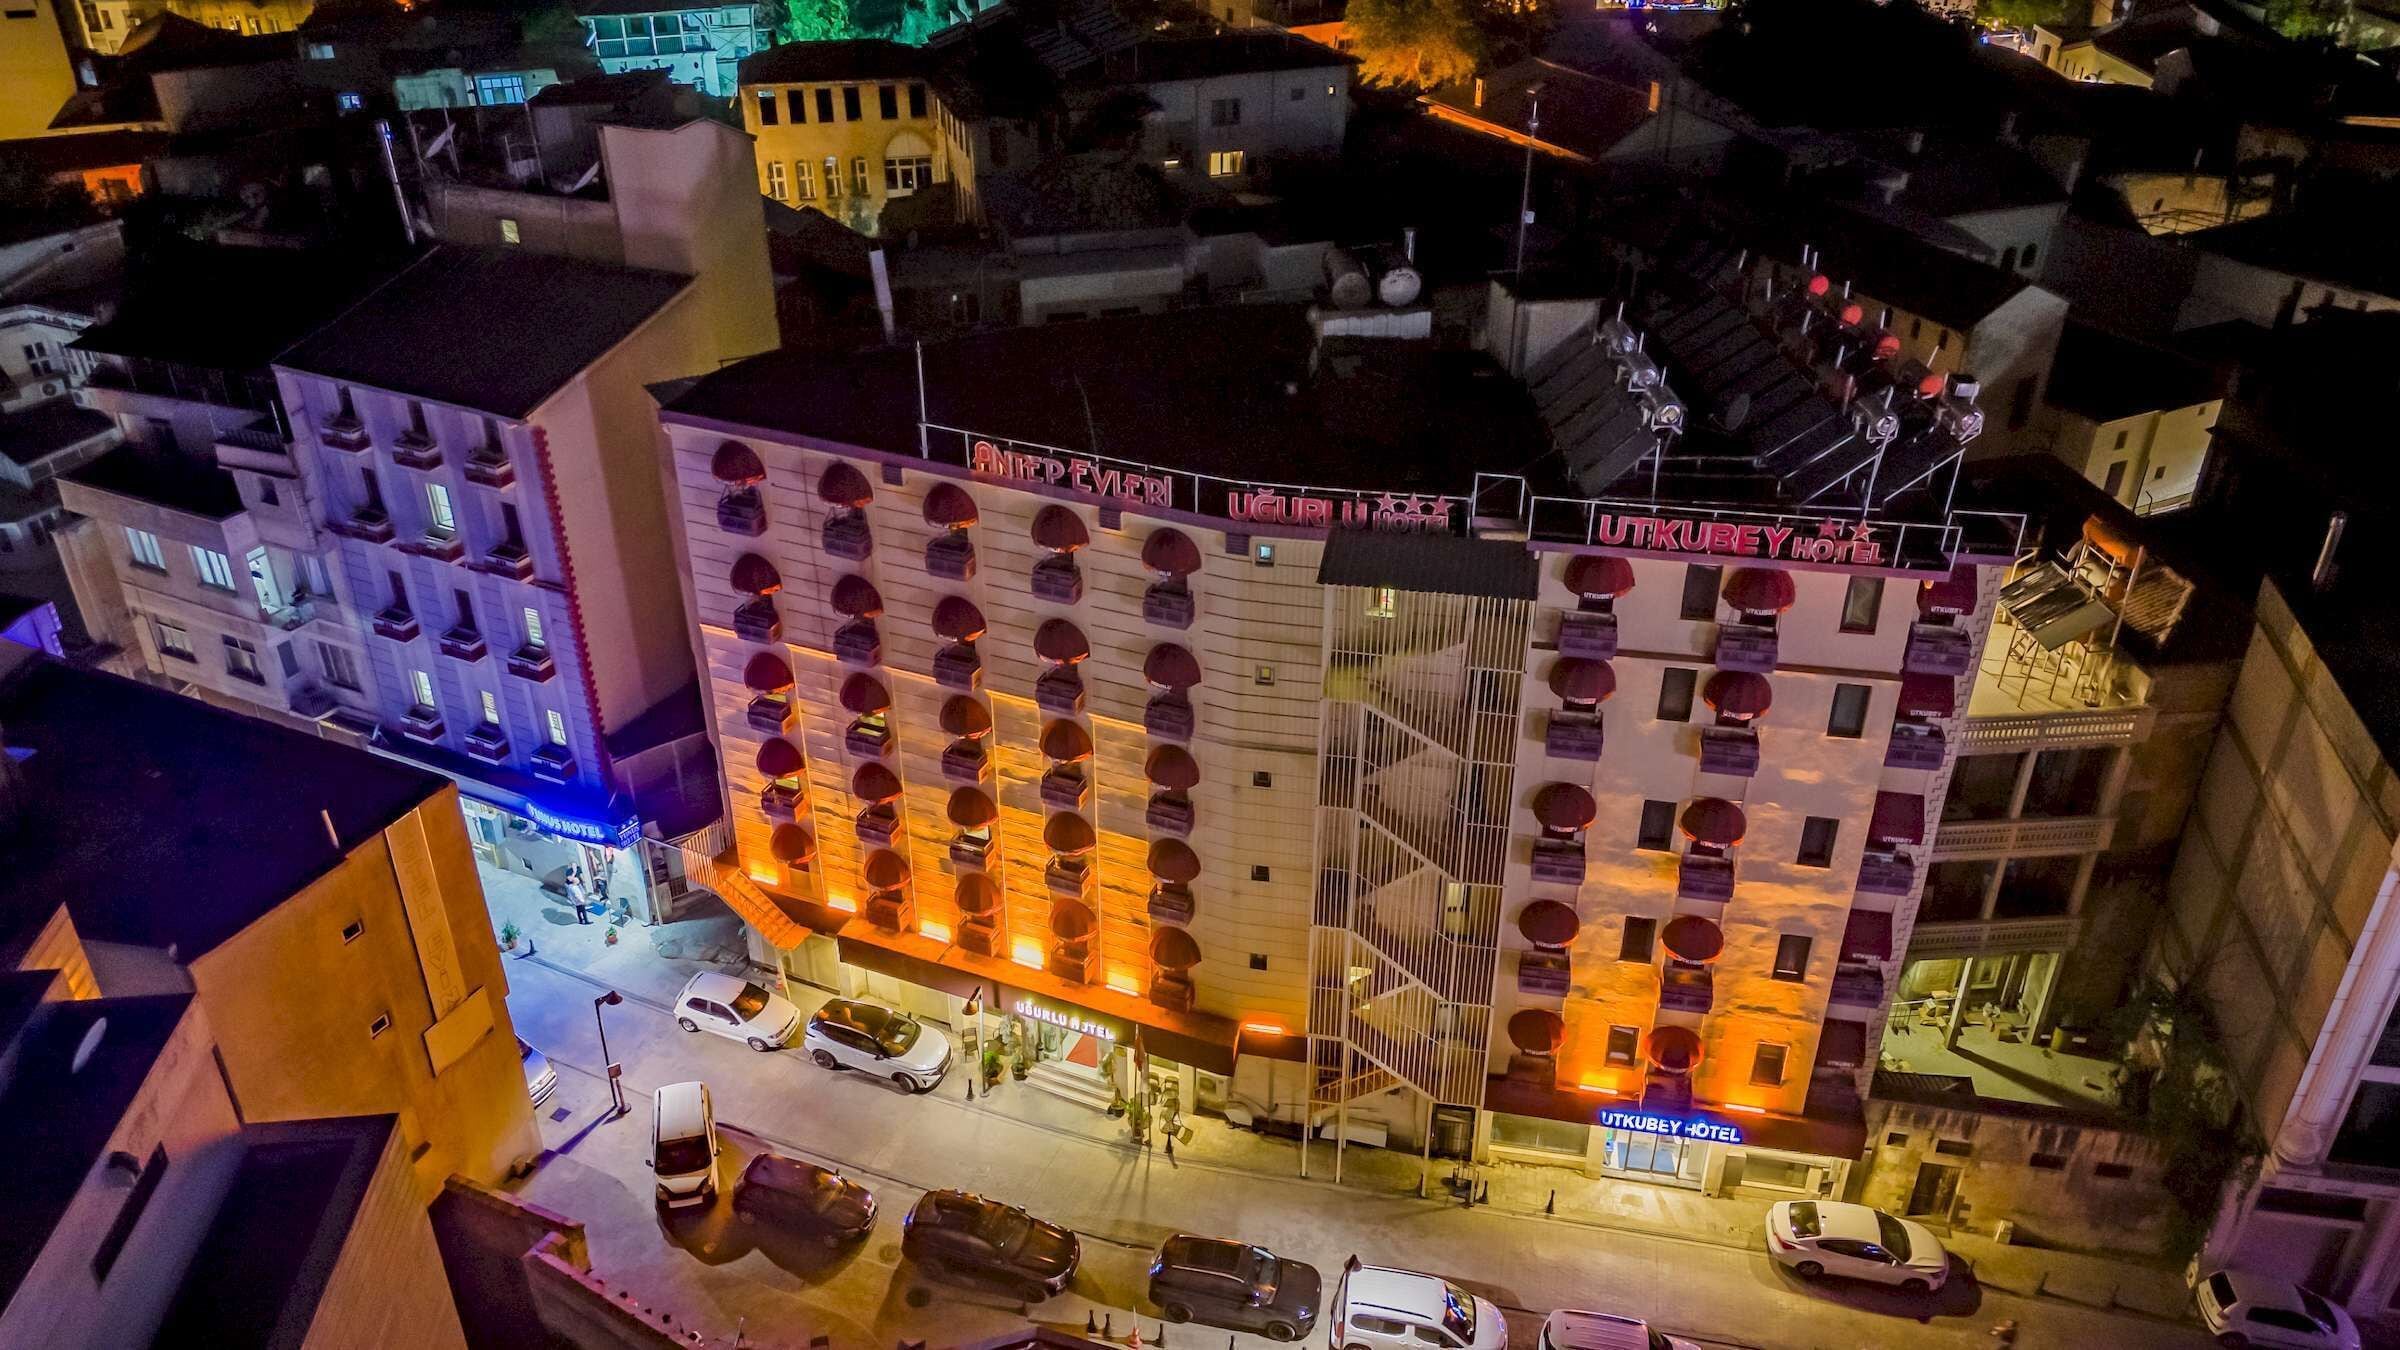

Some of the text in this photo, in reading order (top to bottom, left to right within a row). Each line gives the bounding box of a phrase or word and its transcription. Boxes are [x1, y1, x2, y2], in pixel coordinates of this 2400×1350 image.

[973, 441, 1065, 485] ANTEP
[1600, 514, 1885, 564] UTKUBEY HOTEL
[561, 820, 605, 838] HOTEL
[1601, 1111, 1740, 1142] UTKUBEY HOTEL
